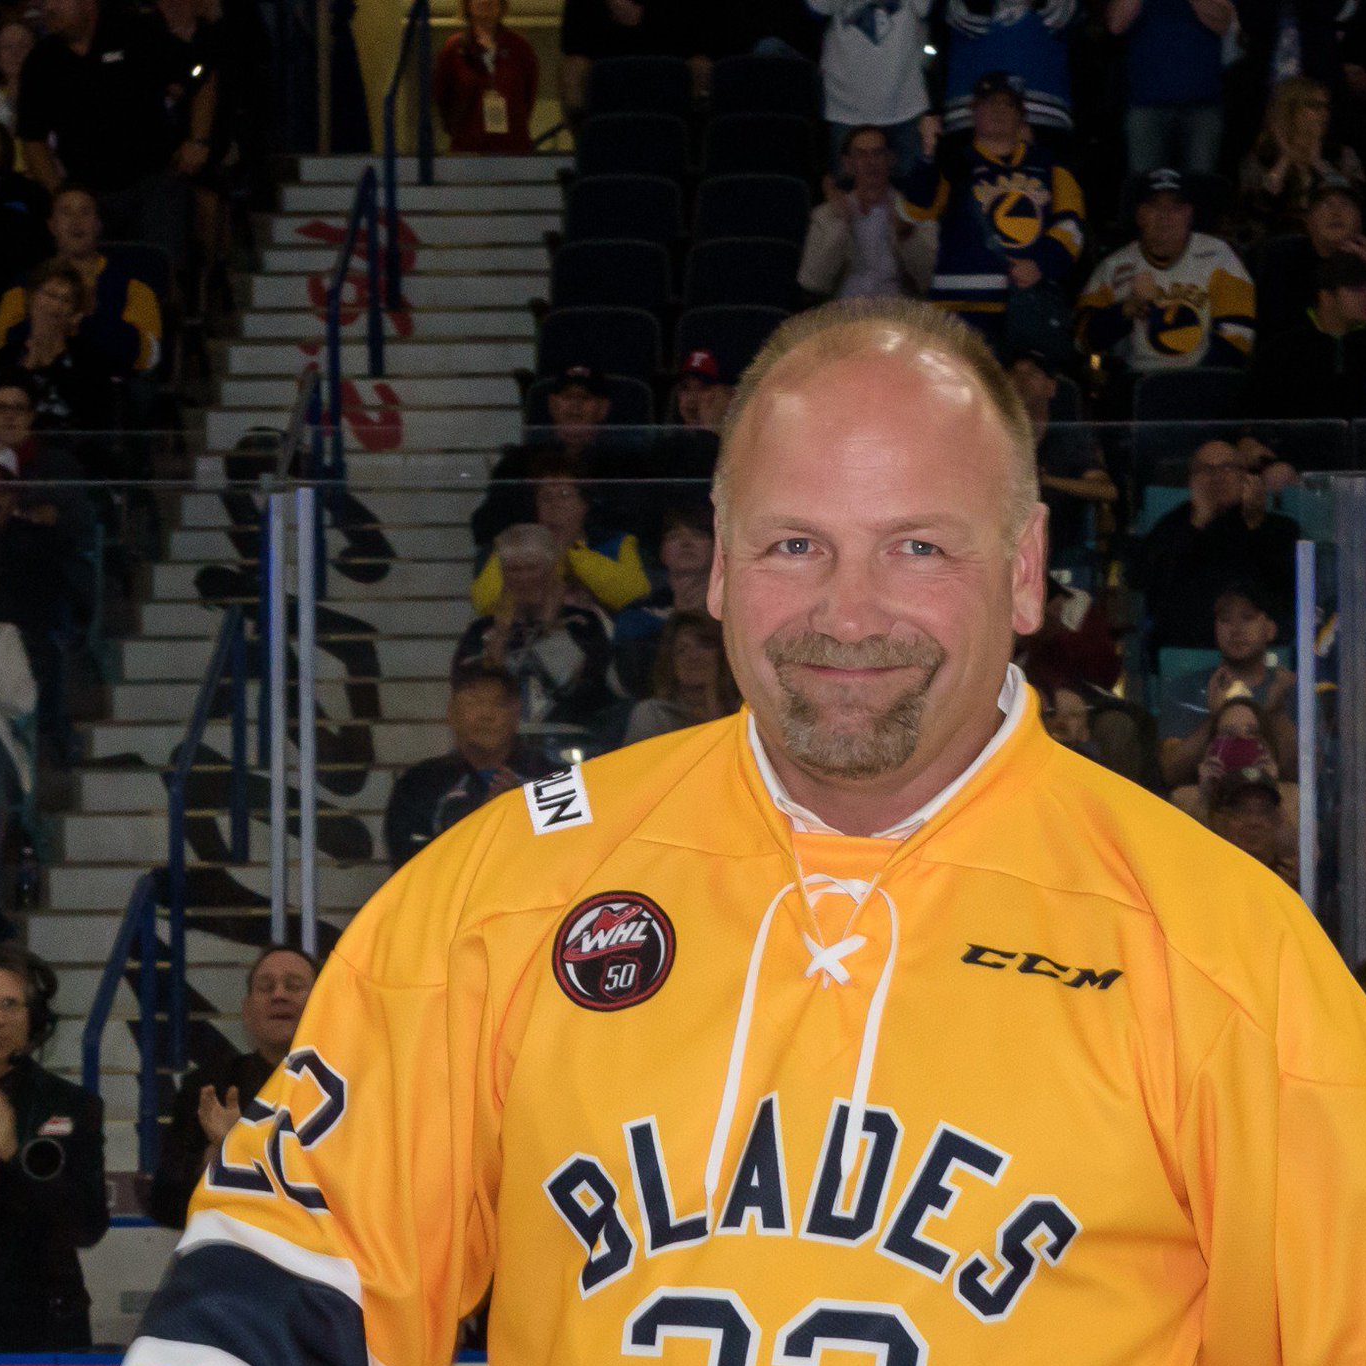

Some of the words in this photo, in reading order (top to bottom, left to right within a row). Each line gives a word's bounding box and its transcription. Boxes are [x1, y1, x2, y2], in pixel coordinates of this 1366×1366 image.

[533, 768, 583, 828] LIN
[581, 921, 651, 953] WHL
[605, 963, 636, 991] 50
[960, 942, 1125, 990] CCM
[541, 1088, 1085, 1324] BLADES
